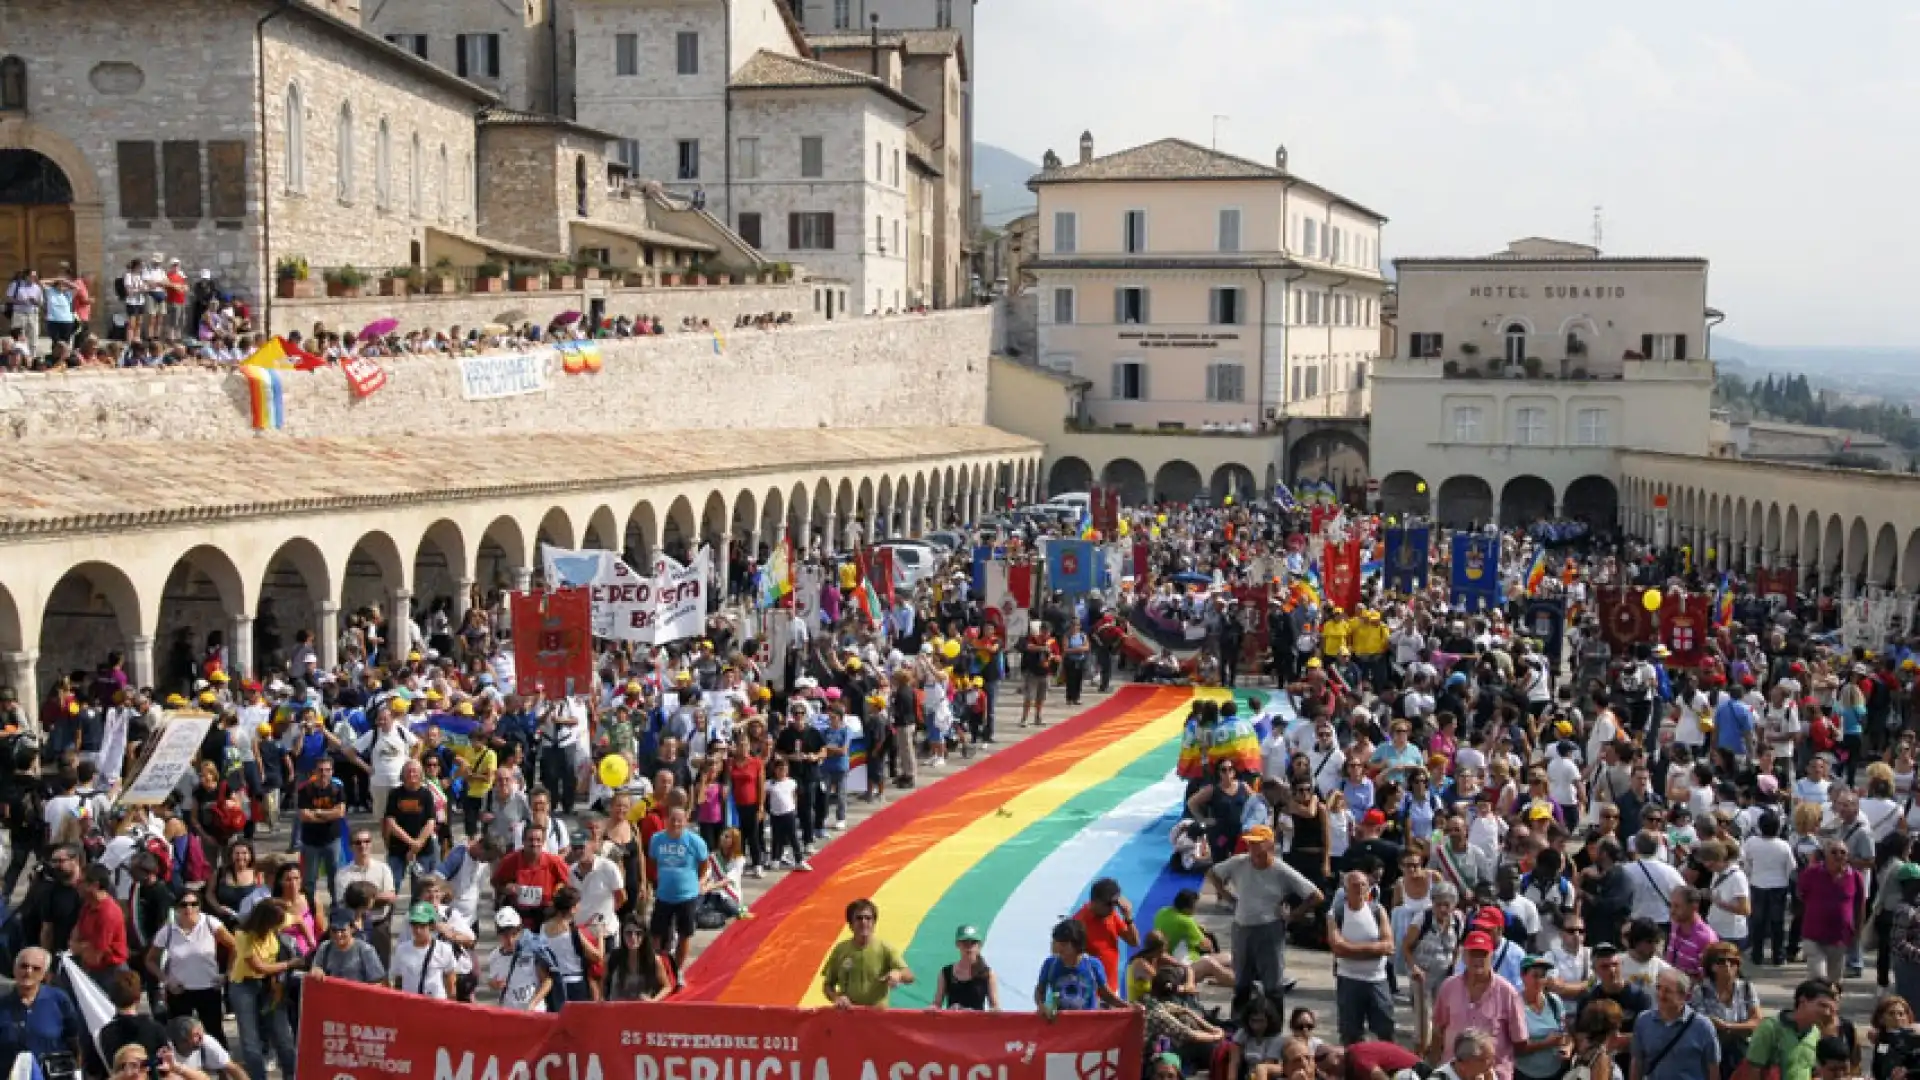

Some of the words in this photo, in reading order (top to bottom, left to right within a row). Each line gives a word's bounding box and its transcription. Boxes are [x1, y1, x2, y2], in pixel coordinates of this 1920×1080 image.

[1470, 286, 1530, 299] HOTEL
[1545, 286, 1625, 299] SUBASIO
[621, 1030, 643, 1045] 25
[645, 1032, 760, 1049] SETTEMBRE
[763, 1036, 798, 1051] 2011
